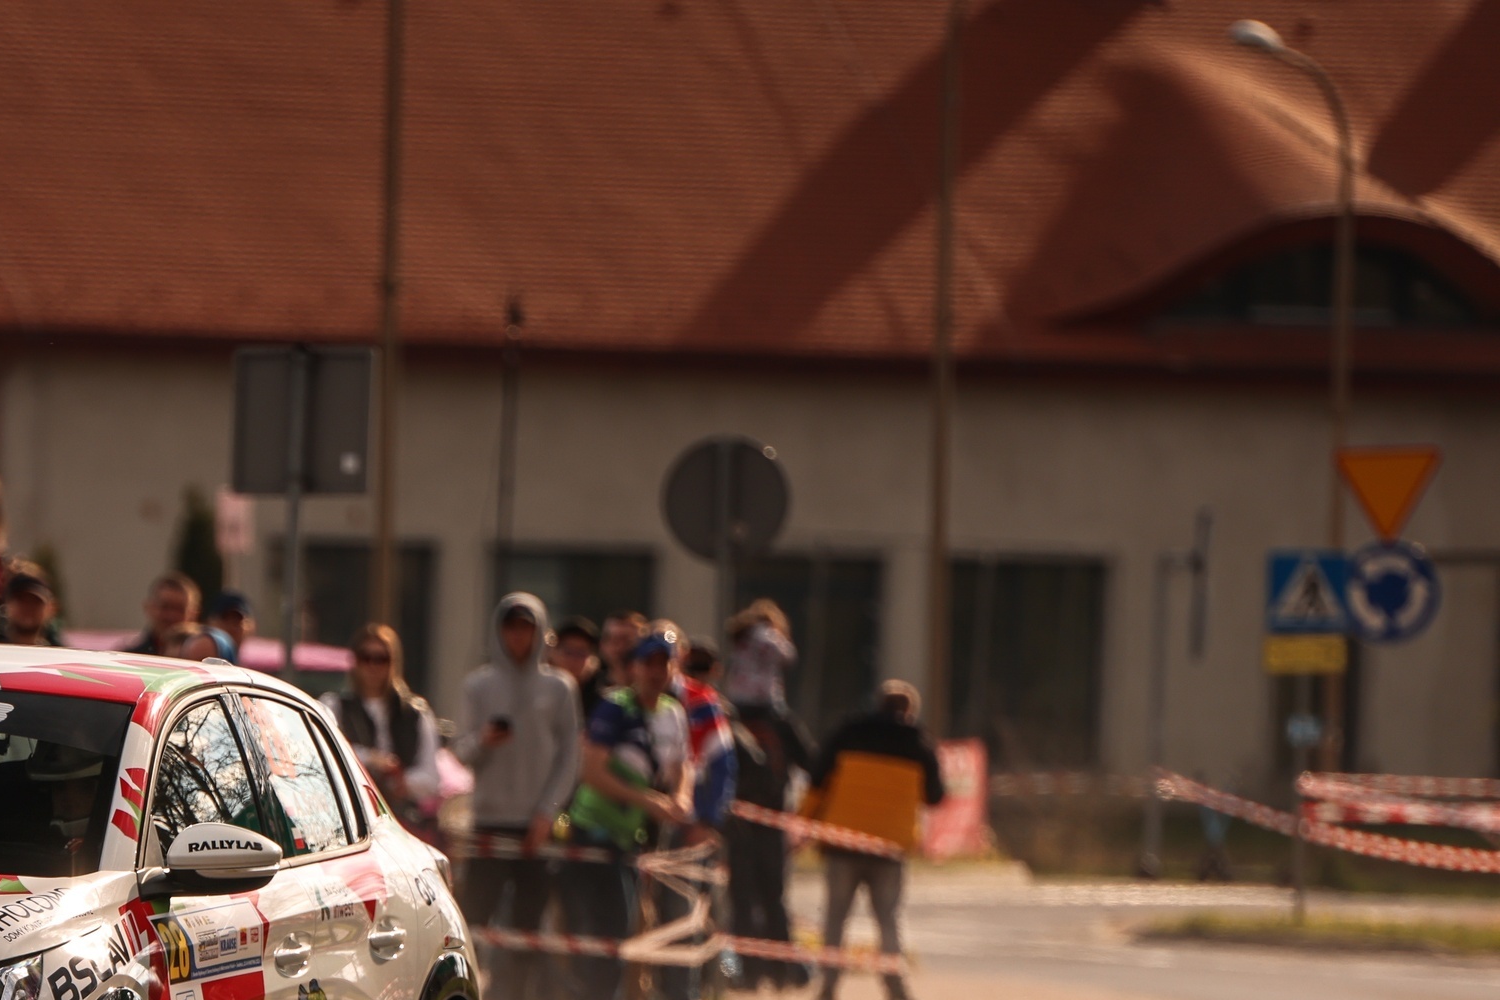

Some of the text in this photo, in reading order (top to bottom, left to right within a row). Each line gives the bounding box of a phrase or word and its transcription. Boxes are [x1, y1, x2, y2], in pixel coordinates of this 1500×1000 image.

[187, 839, 264, 853] RALLYLAB
[157, 920, 190, 980] 28
[219, 936, 238, 954] KRAUSE
